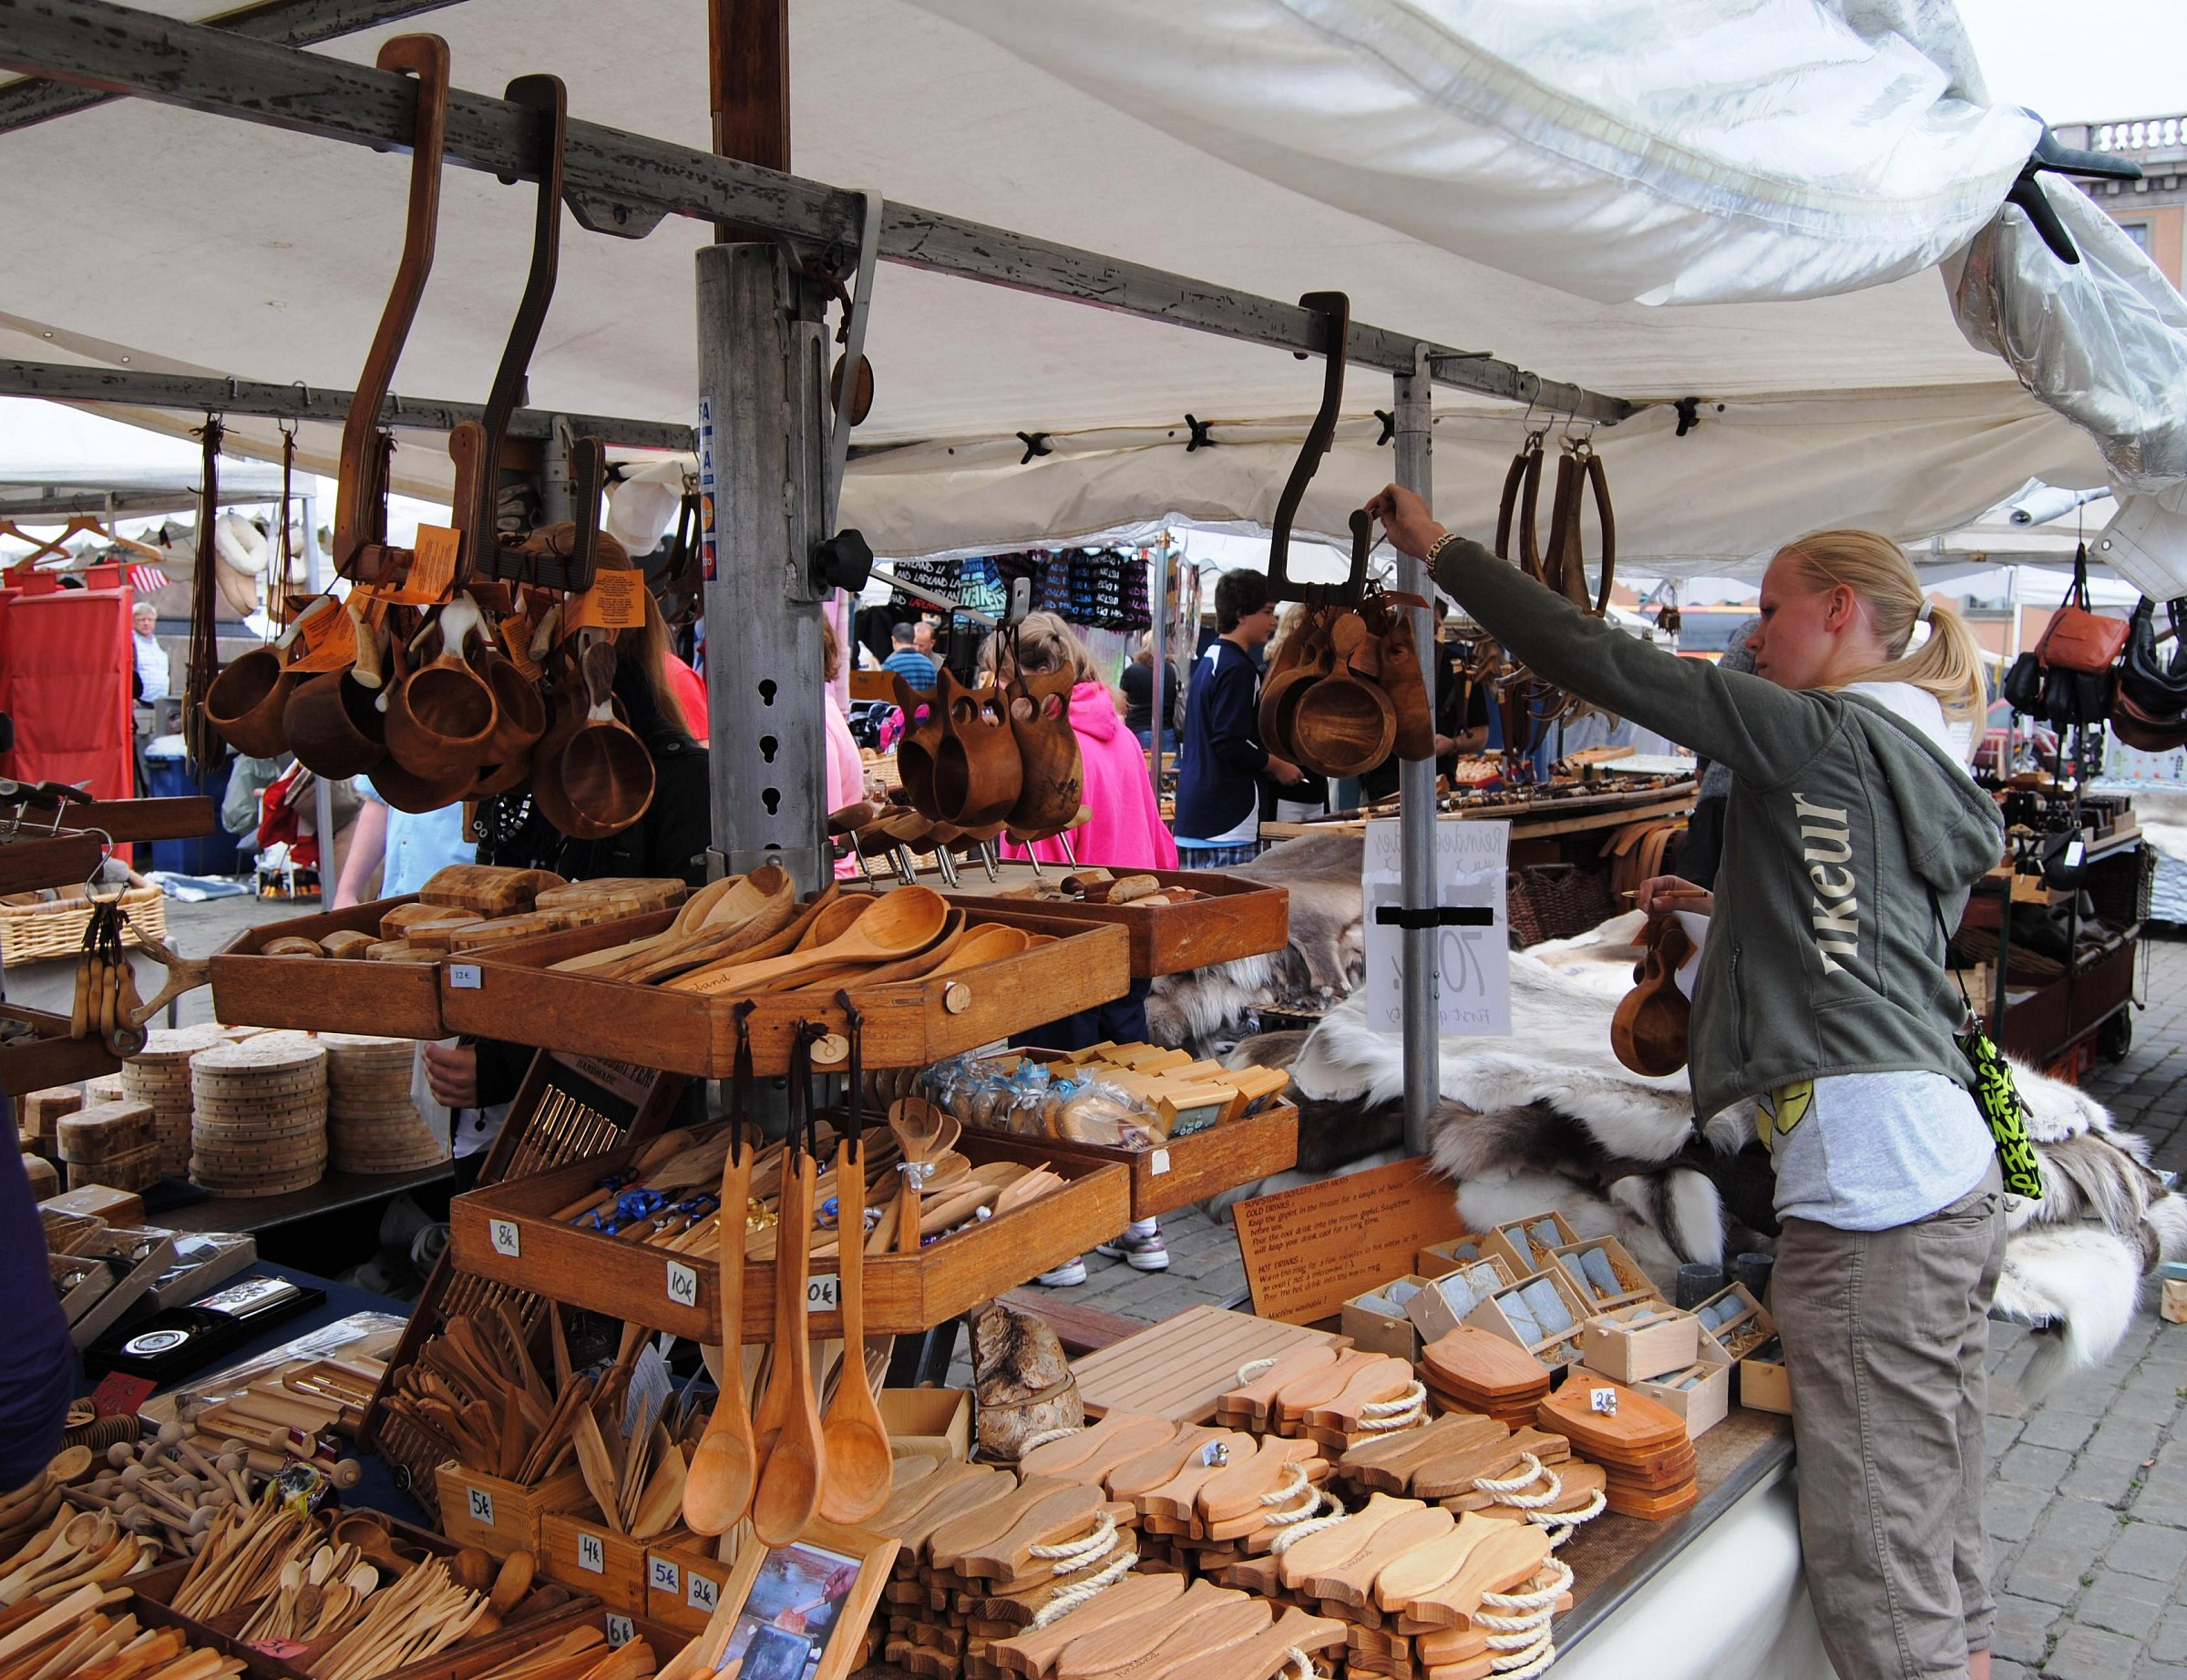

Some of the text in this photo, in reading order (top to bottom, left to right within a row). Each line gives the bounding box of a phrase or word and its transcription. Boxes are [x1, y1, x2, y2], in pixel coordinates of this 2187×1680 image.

[576, 1058, 617, 1086] HANDMADE
[1314, 1181, 1328, 1191] AND
[1246, 1206, 1263, 1217] COLD
[1248, 1218, 1263, 1226] Keep
[1308, 1204, 1317, 1212] the
[1253, 1237, 1266, 1245] Pour
[1268, 1233, 1278, 1241] the
[1295, 1224, 1310, 1234] drink
[1300, 1233, 1316, 1242] drink
[1258, 1263, 1270, 1274] HOT
[672, 1271, 693, 1302] 10€
[808, 1283, 833, 1304] 0€
[471, 1490, 490, 1519] 5€
[583, 1536, 601, 1563] 4€
